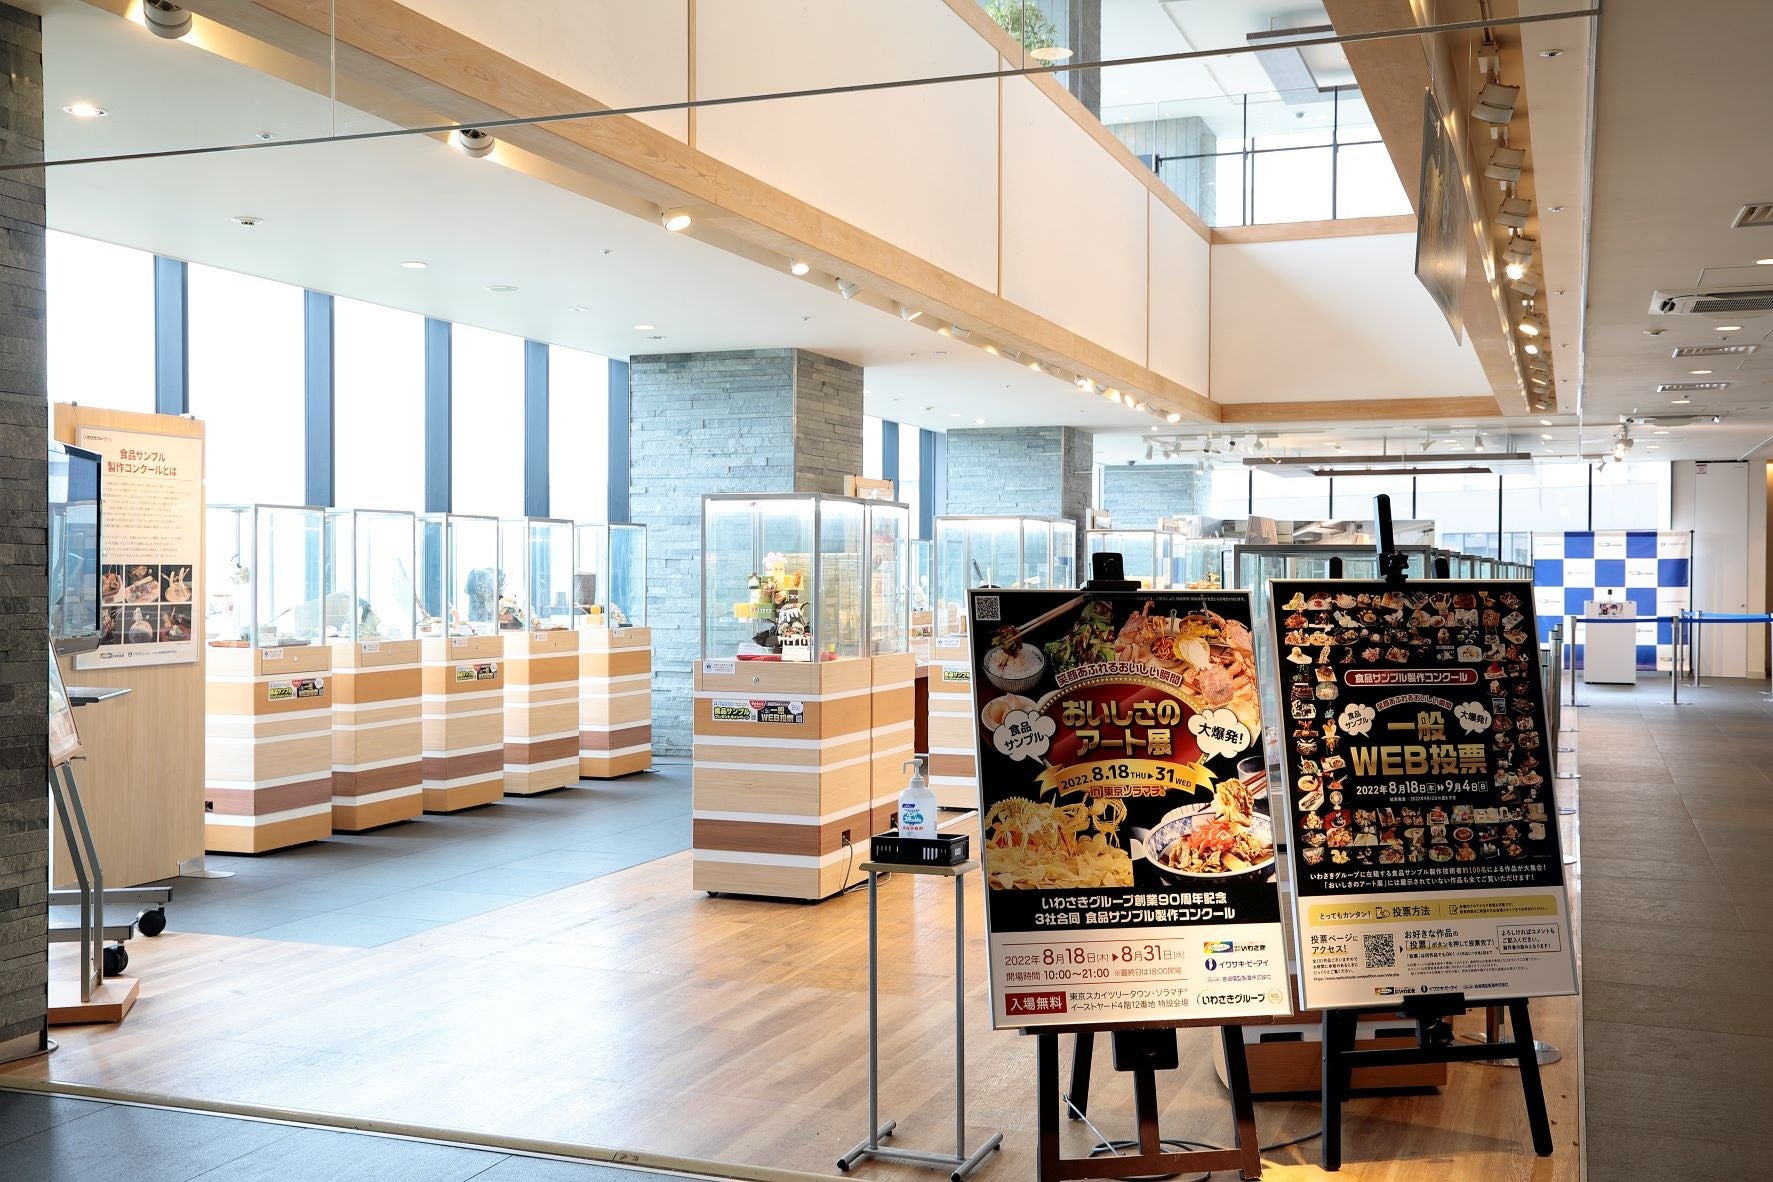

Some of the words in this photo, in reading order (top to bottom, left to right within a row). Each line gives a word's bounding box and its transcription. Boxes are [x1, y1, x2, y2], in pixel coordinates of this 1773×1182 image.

[120, 448, 166, 463] 食品サンプル
[107, 461, 177, 476] 製作コンクールとは
[1056, 661, 1183, 687] 笑顔あふれるおいしい瞬間
[1355, 671, 1468, 685] 食品サンプル製作コンクール
[1062, 699, 1181, 727] おいしさの
[1347, 711, 1362, 721] 食品
[1008, 721, 1033, 737] 食品
[1345, 718, 1370, 730] サンプル
[1387, 711, 1447, 742] 一般
[1004, 732, 1045, 752] サンプル
[1076, 728, 1172, 757] アート展
[1350, 744, 1487, 777] WEB投票
[1130, 771, 1146, 779] THU
[1155, 766, 1175, 783] 31
[1175, 777, 1192, 788] WED
[1042, 892, 1227, 909] いわさきグループ創業90周年記念
[1035, 912, 1080, 925] 3社合同
[1086, 908, 1236, 924] 食品サンプル製作コンクール
[1393, 905, 1430, 917] 投票方法
[1311, 933, 1358, 944] 投票ページに
[1404, 929, 1459, 939] お好きな作品の
[1006, 971, 1041, 982] 開場時間
[1010, 995, 1063, 1011] 入場無料
[1071, 1000, 1157, 1011] イーストヤード4階12番地
[1158, 999, 1189, 1008] 特設会場
[1202, 993, 1266, 1005] いわさきグループ
